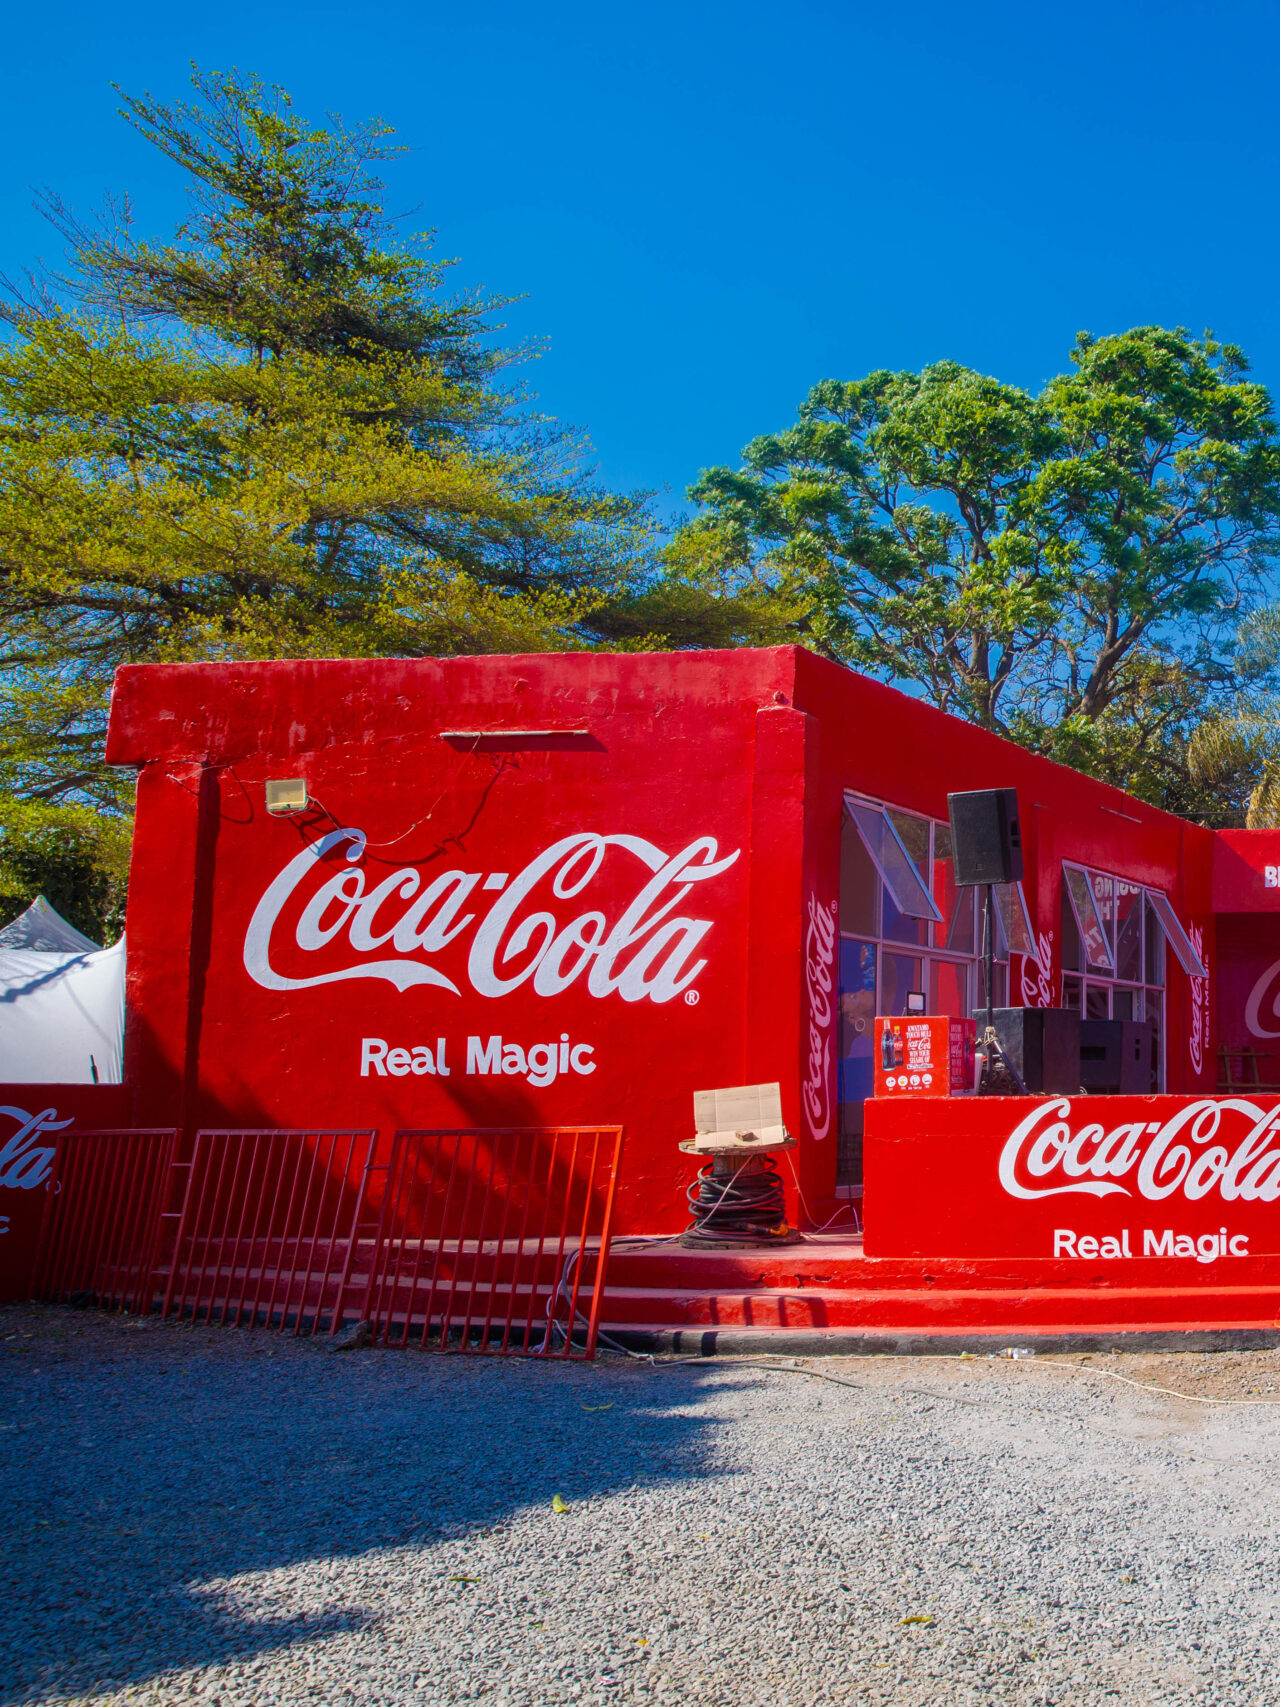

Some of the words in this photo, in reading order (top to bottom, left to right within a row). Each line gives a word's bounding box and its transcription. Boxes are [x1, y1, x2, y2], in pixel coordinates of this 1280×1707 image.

[243, 828, 741, 1003] Coca-Cola
[360, 1037, 451, 1077] Real
[466, 1032, 597, 1087] Magic
[803, 891, 836, 1141] Coca-Cola
[1053, 1228, 1133, 1259] Real
[1143, 1226, 1249, 1264] Magic
